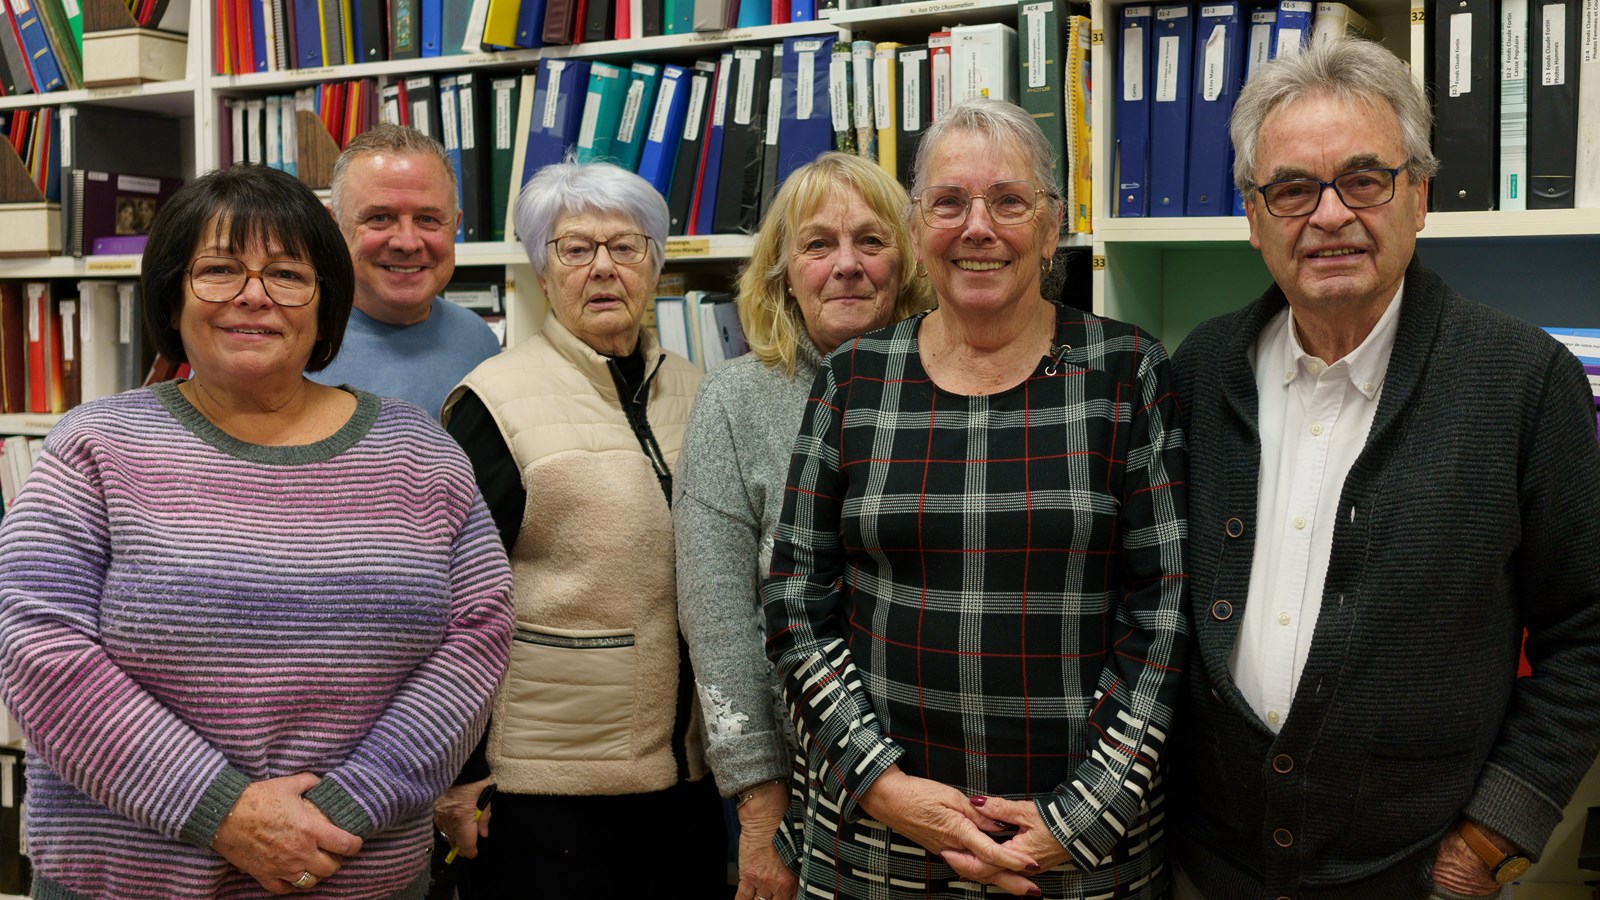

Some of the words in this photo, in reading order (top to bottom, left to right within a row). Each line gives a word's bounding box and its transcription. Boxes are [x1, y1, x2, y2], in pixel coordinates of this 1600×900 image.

[1411, 12, 1425, 21] 32
[1092, 33, 1104, 42] 31
[1093, 258, 1106, 267] 33
